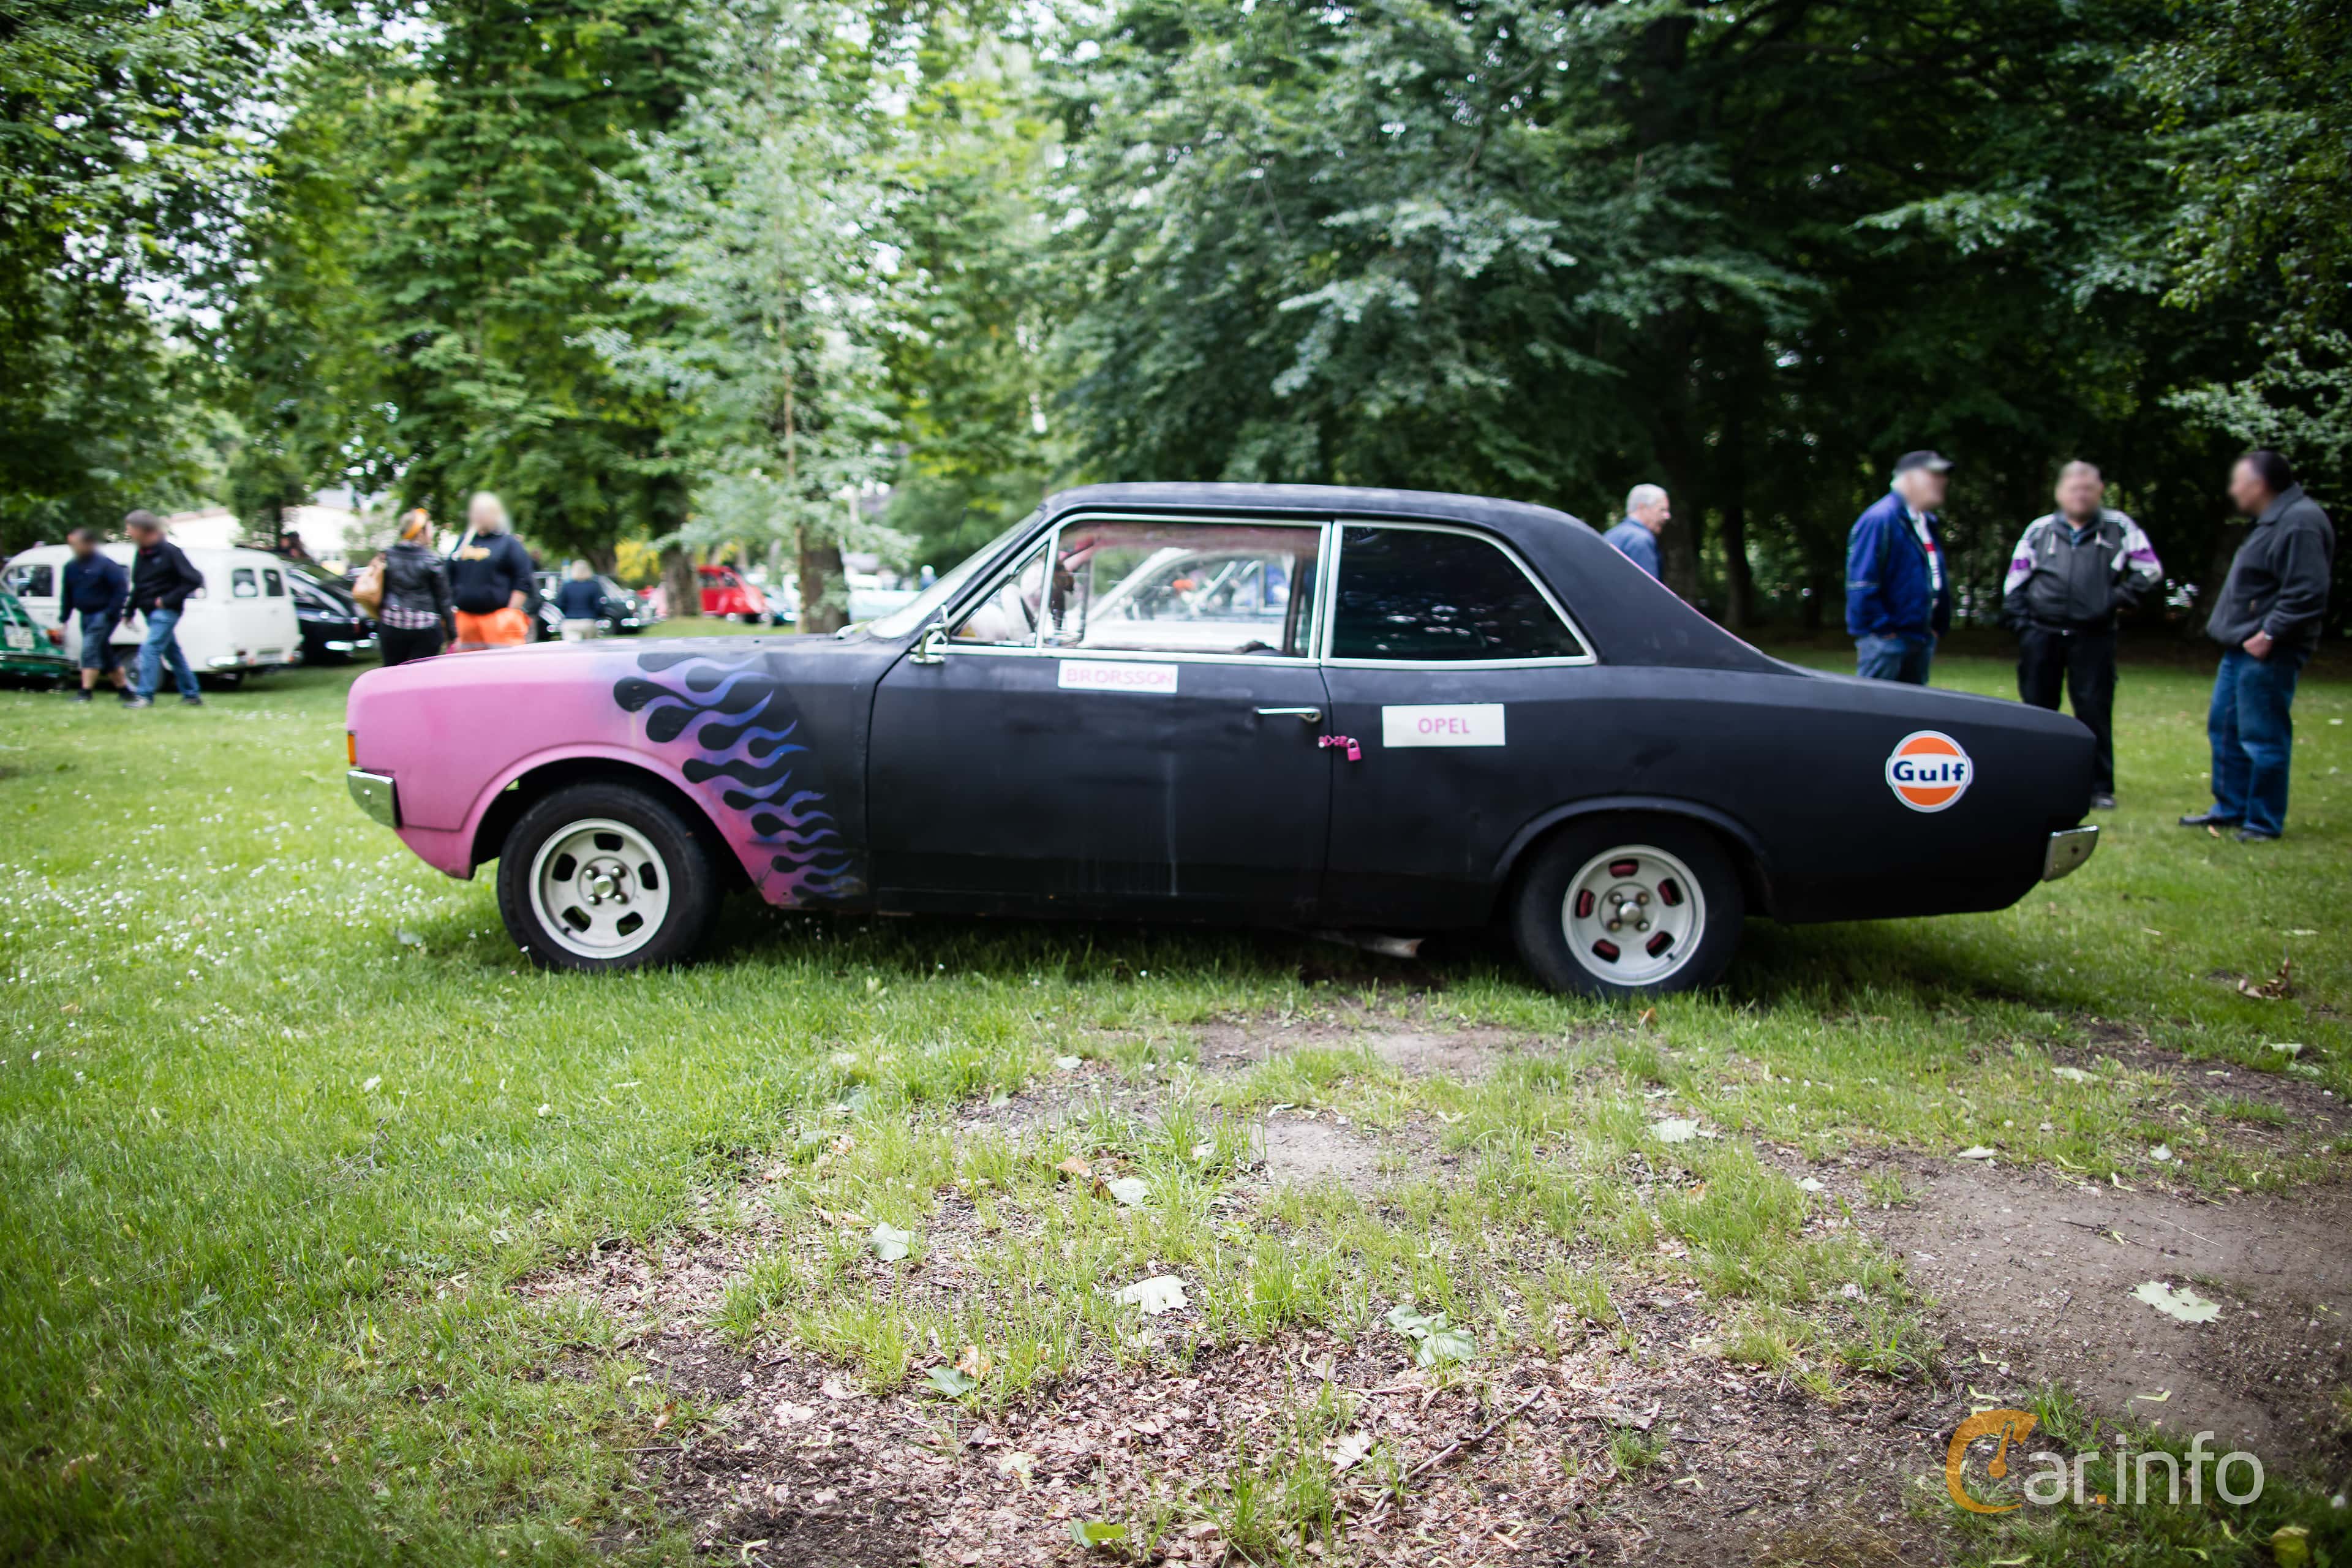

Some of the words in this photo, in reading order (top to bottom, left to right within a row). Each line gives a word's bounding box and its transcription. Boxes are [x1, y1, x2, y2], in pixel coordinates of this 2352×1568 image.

[1066, 668, 1173, 685] BRORSSON
[1418, 718, 1471, 734] OPEL
[1893, 761, 1965, 781] Gulf
